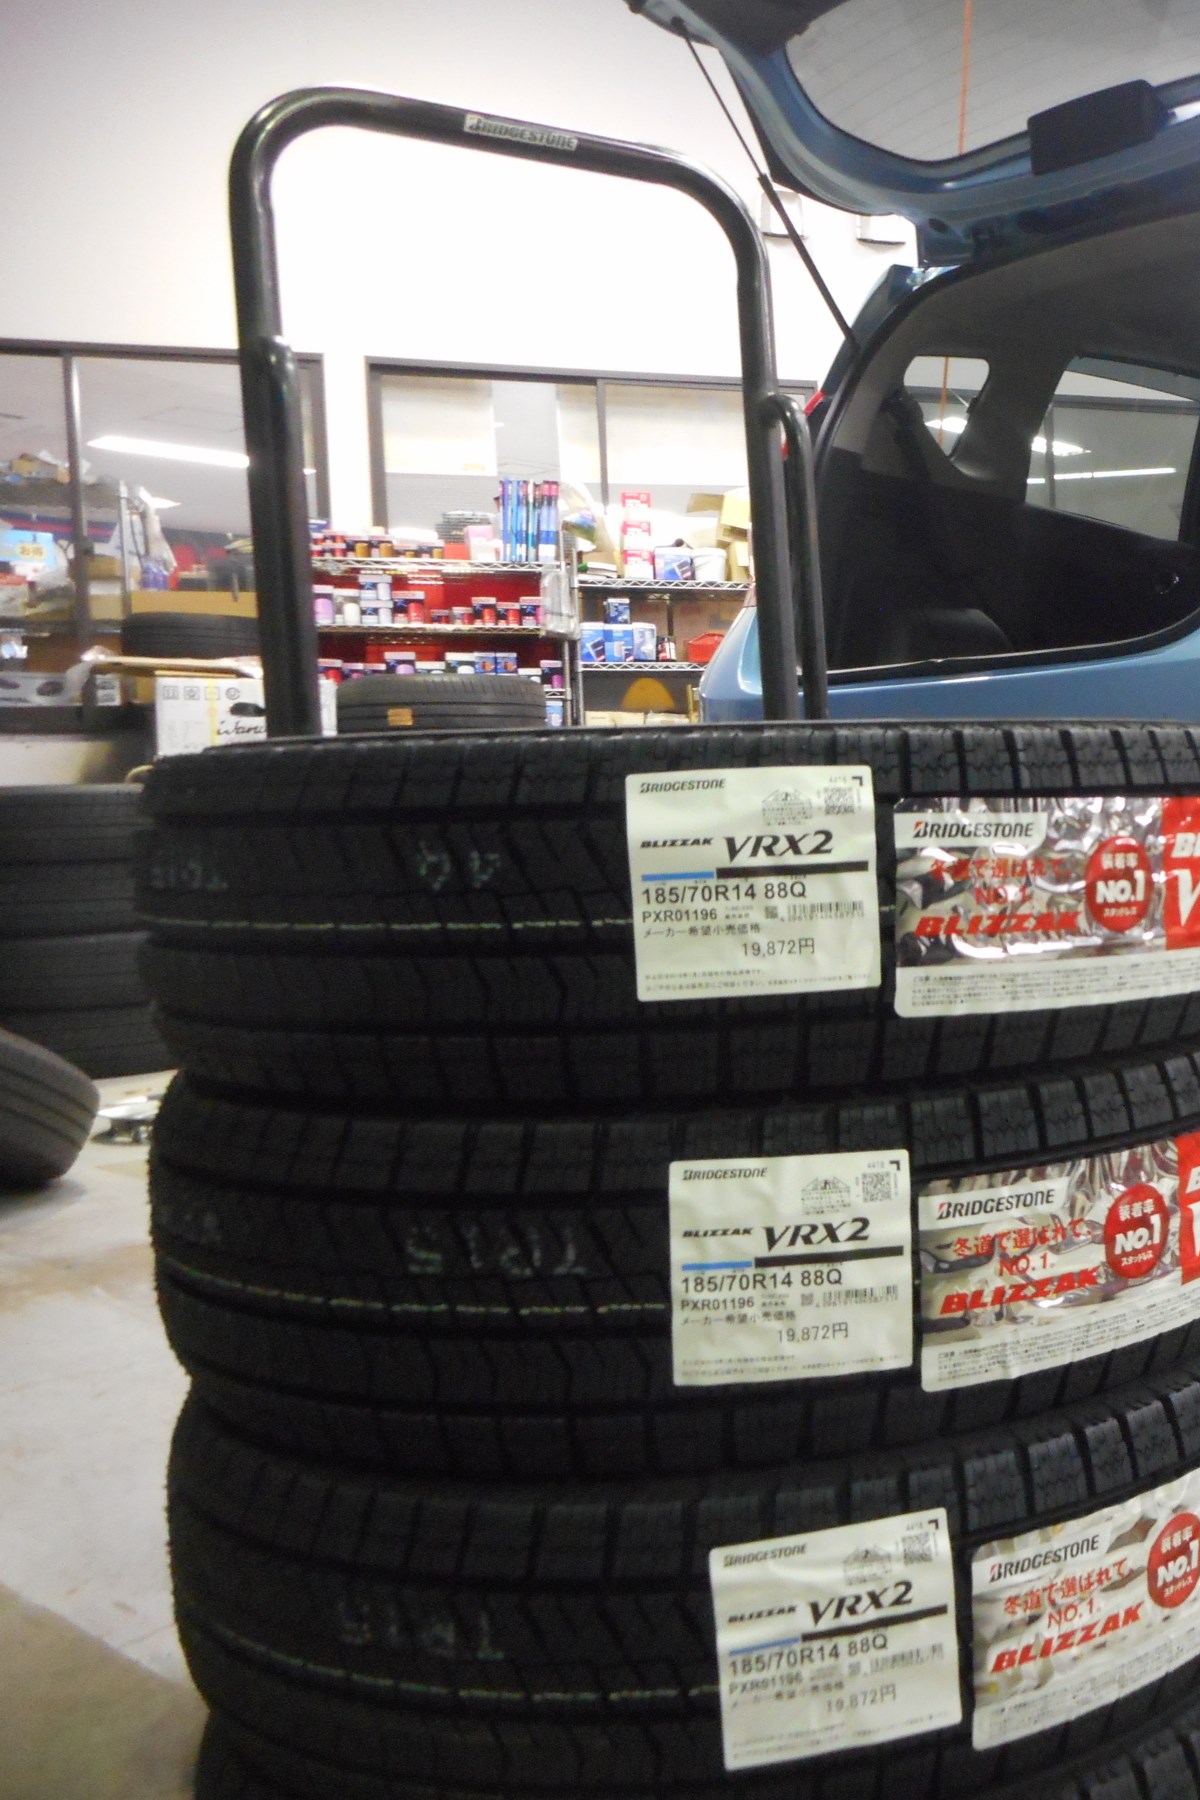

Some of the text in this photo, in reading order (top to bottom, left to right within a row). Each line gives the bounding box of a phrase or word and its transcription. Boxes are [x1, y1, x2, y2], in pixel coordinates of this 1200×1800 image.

[469, 117, 576, 149] BRIDGESTONE
[639, 778, 726, 794] BRIDGESTONE
[913, 821, 1034, 839] BRIDGESTONE
[640, 830, 833, 863] BLIZZAK VRX2
[642, 881, 807, 905] 185/70R14 88Q
[1096, 869, 1146, 904] NO.1
[642, 908, 717, 923] PXR01196
[914, 911, 1082, 937] BLIZZAK
[643, 923, 761, 938] メーカー希望小売価格
[742, 937, 815, 958] 19,872円
[682, 1167, 767, 1181] BRIDGESTONE
[936, 1188, 1055, 1221] BRIDGESTONE
[682, 1216, 870, 1252] BLIZZAK VRX2
[1115, 1213, 1160, 1255] NO.1
[681, 1268, 842, 1294] 185/70R14 88Q
[940, 1266, 1100, 1315] BLIZZAK
[681, 1297, 755, 1311] PXR01196
[682, 1310, 796, 1326] メーカー希望小売価格
[777, 1322, 849, 1344] 19,872円
[723, 1543, 807, 1568] BRIDGESTONE
[989, 1534, 1100, 1583] BRIDGESTONE
[1157, 1539, 1199, 1588] NO.1
[728, 1580, 912, 1627] BLIZZAK VRX2
[991, 1600, 1145, 1673] BLIZZAK
[729, 1645, 841, 1676] 185/70R14
[848, 1633, 888, 1657] 88Q
[826, 1683, 897, 1712] 19,872円
